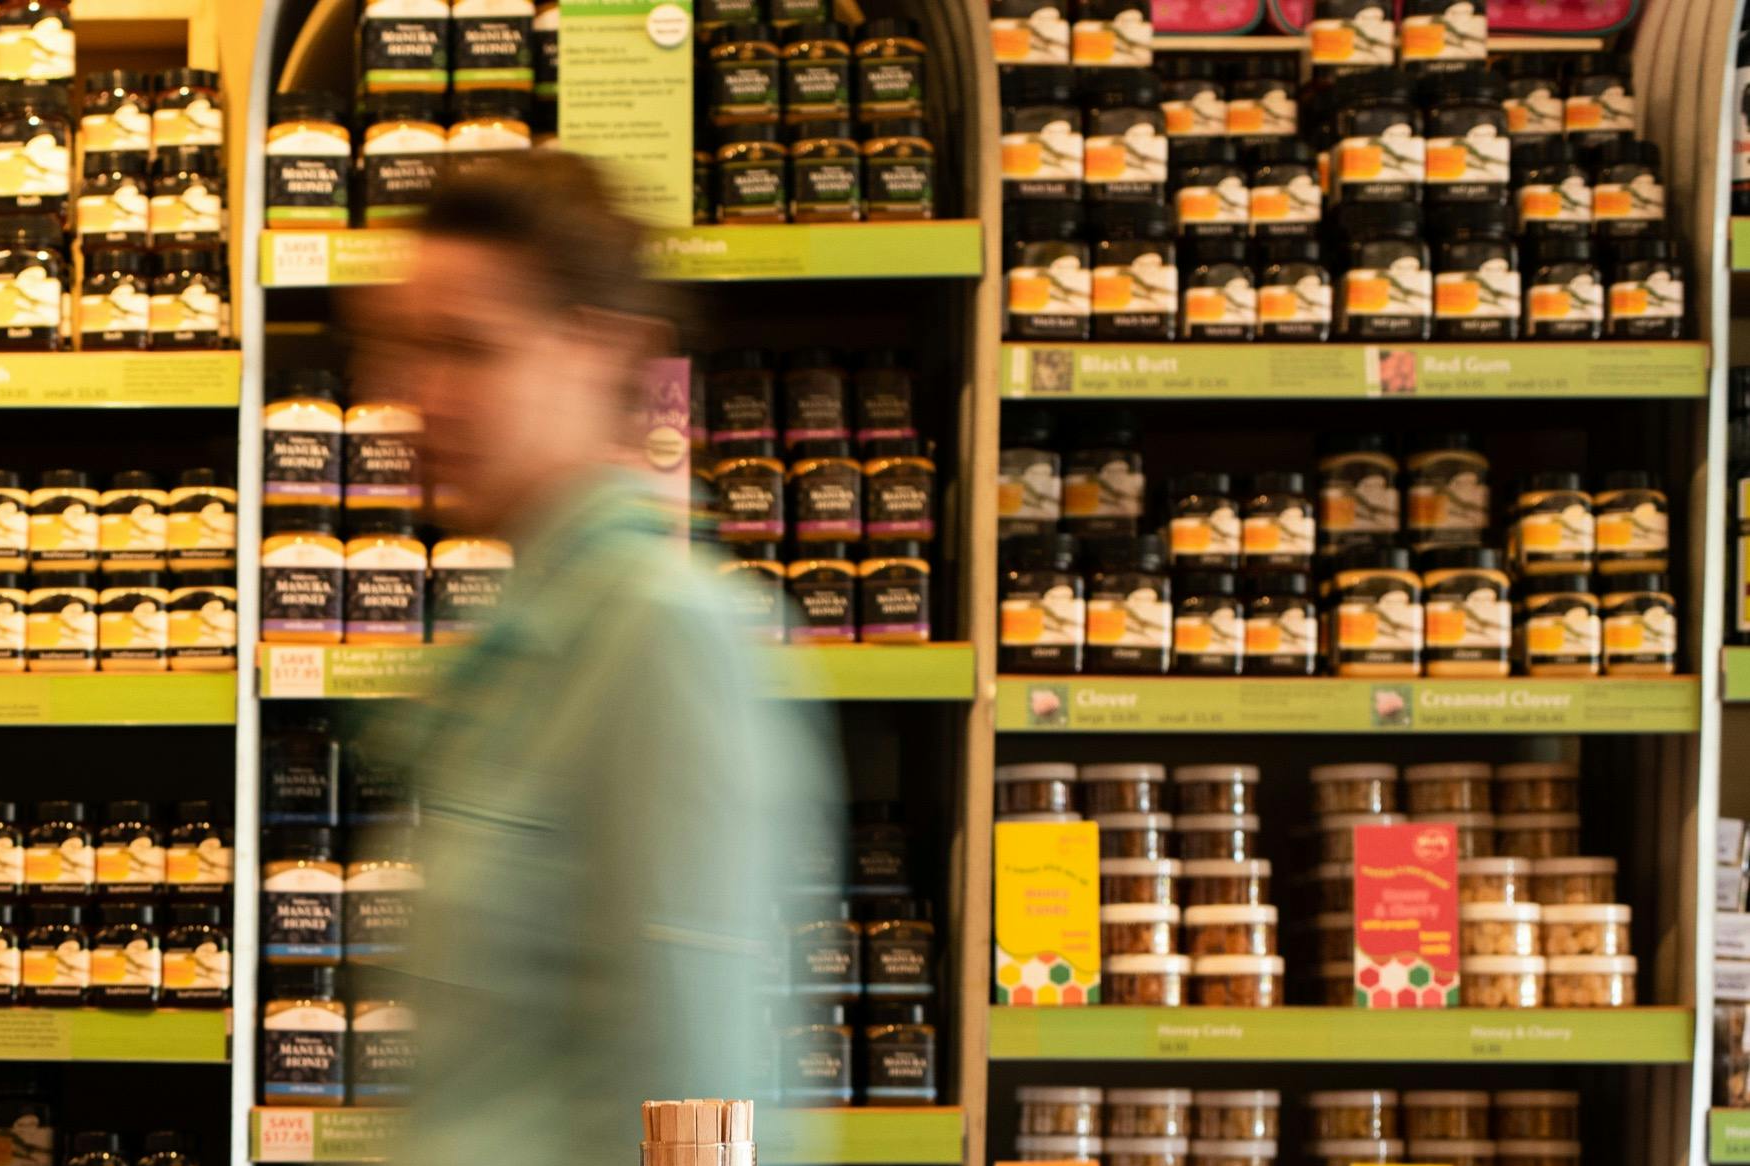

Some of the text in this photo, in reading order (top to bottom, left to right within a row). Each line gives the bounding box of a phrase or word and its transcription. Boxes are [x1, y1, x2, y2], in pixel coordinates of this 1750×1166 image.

[1080, 355, 1178, 373] Black Butt
[1423, 356, 1511, 374] Red Gum
[1076, 688, 1137, 707] Clover
[1420, 690, 1506, 708] Creamed
[1509, 690, 1571, 708] Clover
[1158, 1024, 1243, 1039] Honey Candy
[1470, 1026, 1513, 1040] Honey
[269, 1117, 304, 1128] SAVE
